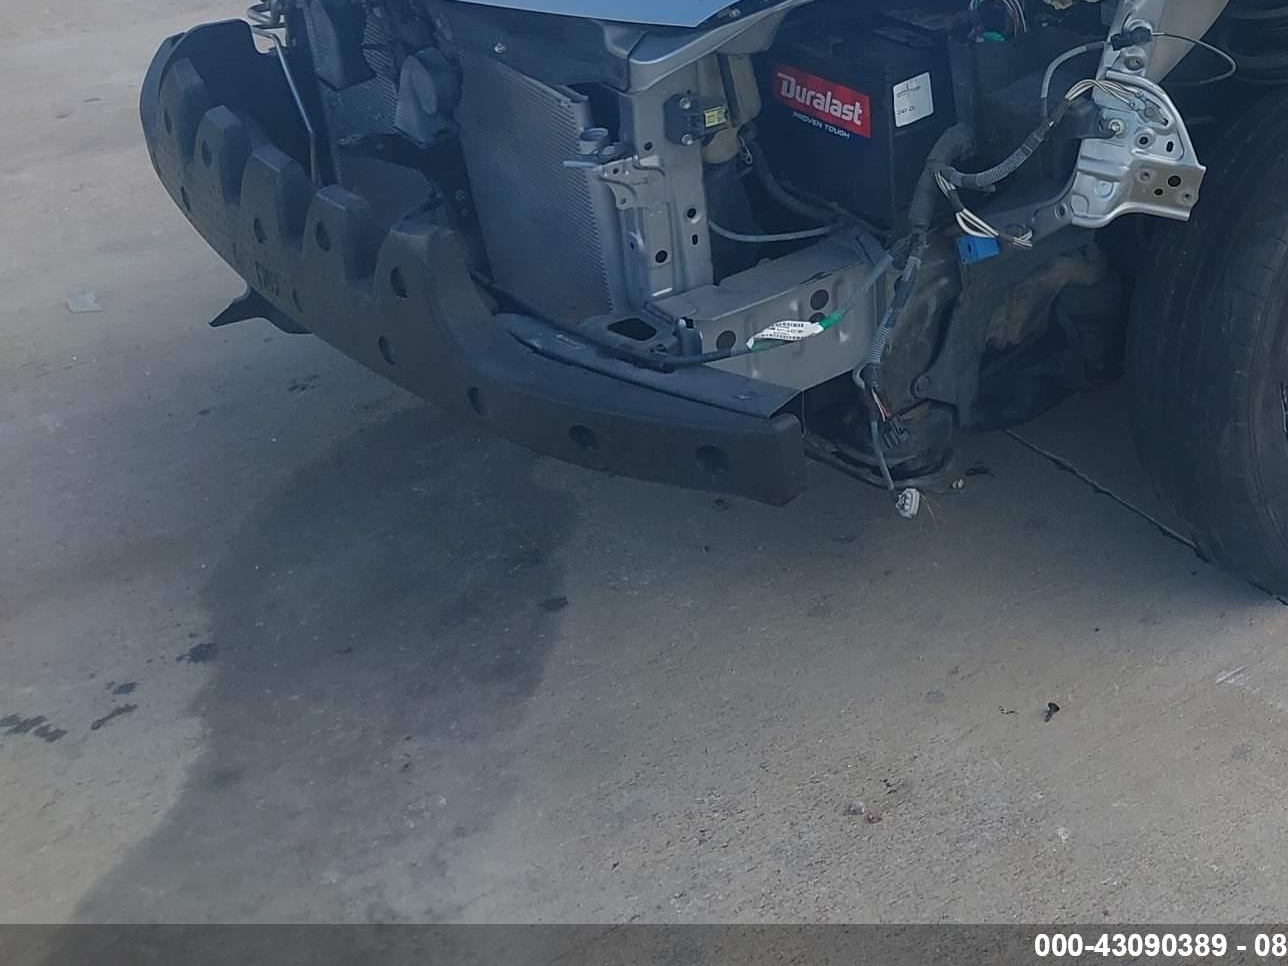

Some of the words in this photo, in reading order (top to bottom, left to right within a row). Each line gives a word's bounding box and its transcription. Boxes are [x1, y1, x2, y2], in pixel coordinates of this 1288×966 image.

[776, 72, 863, 126] Duralast
[793, 111, 823, 130] PROVEN
[824, 123, 850, 139] TOUGH
